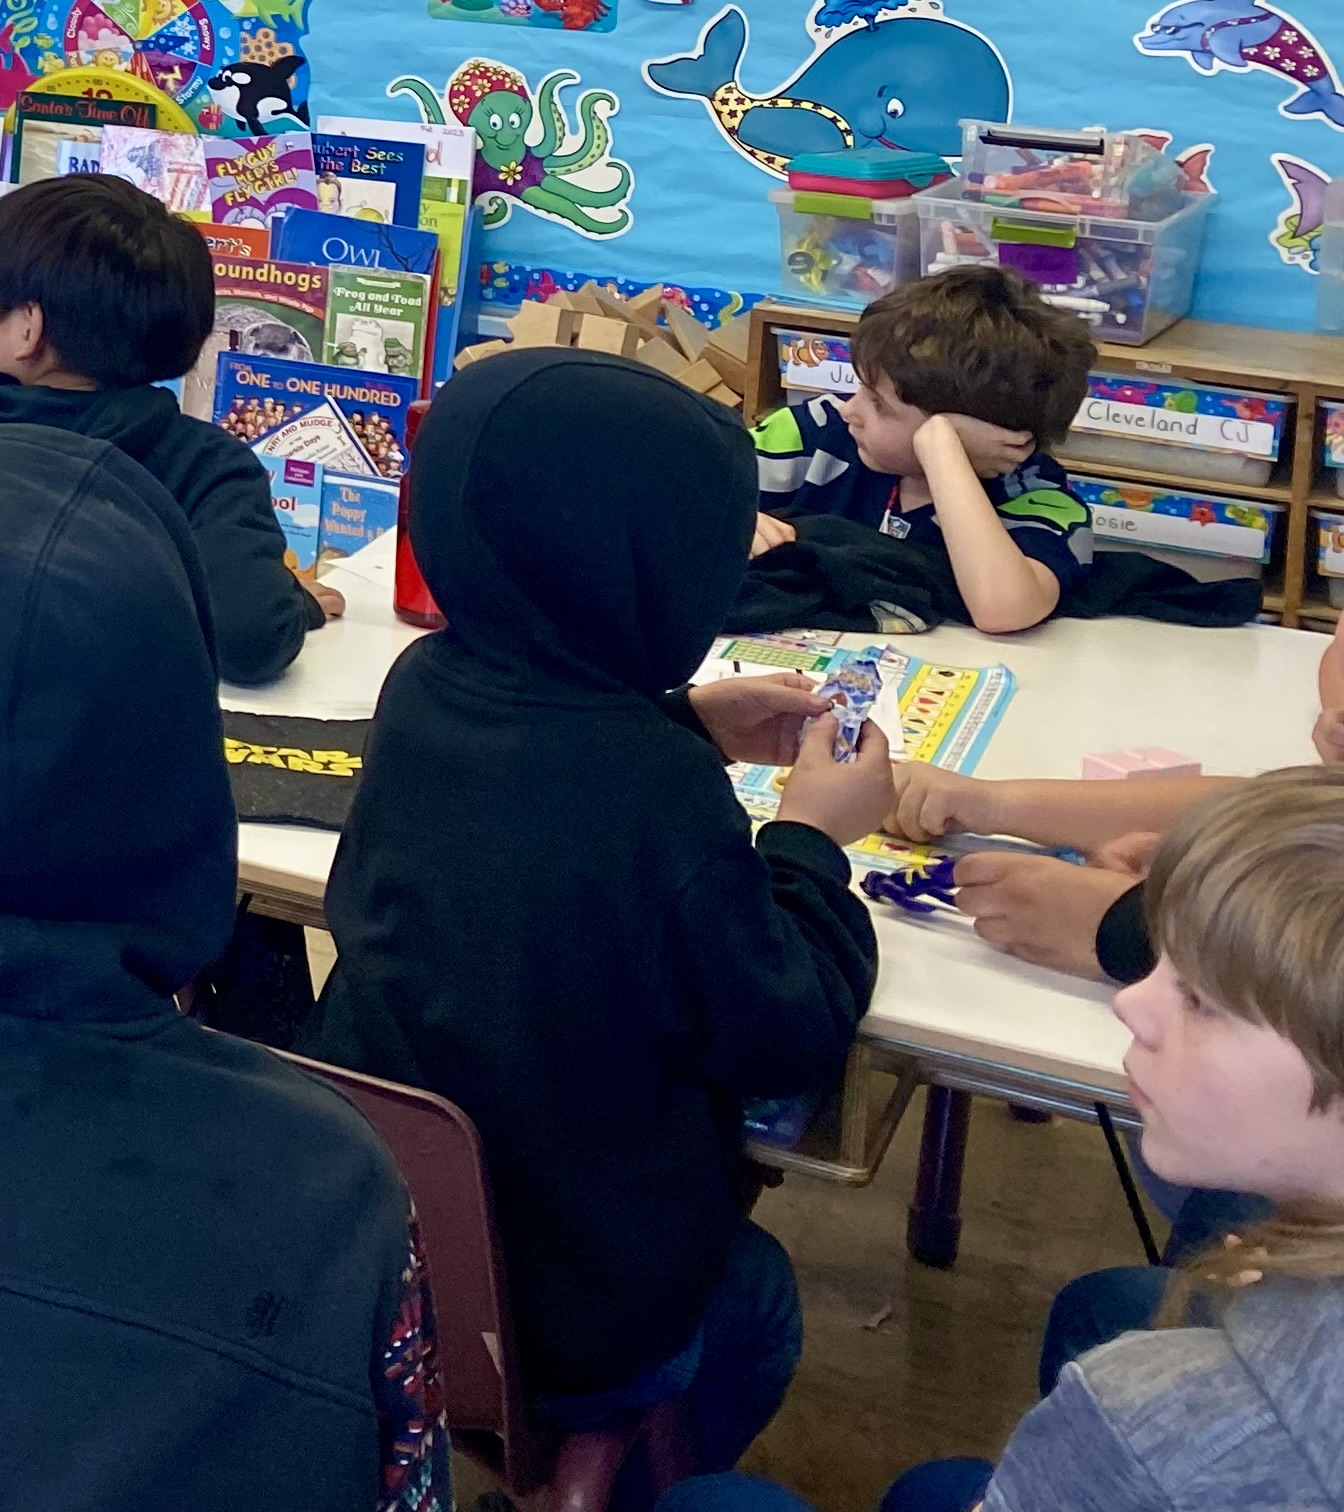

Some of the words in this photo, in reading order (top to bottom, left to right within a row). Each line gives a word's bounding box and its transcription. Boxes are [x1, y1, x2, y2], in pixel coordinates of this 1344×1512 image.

[67, 7, 82, 40] Cloudy
[198, 17, 209, 51] Snowy
[176, 76, 204, 104] Stormy
[216, 158, 244, 179] FLY
[244, 143, 277, 165] GUY
[351, 160, 387, 175] Best
[366, 148, 403, 162] Sees
[234, 160, 280, 183] MEETS
[224, 187, 251, 206] FLY
[255, 168, 299, 192] GIRL!
[334, 288, 365, 303] Frog
[368, 293, 389, 302] and
[392, 295, 422, 307] Toad
[349, 303, 371, 312] All
[374, 305, 404, 317] Year
[236, 371, 271, 388] ONE
[286, 378, 321, 395] ONE
[324, 384, 401, 407] HUNDRED
[1088, 401, 1199, 437] Cleveland
[1220, 418, 1250, 443] CJ
